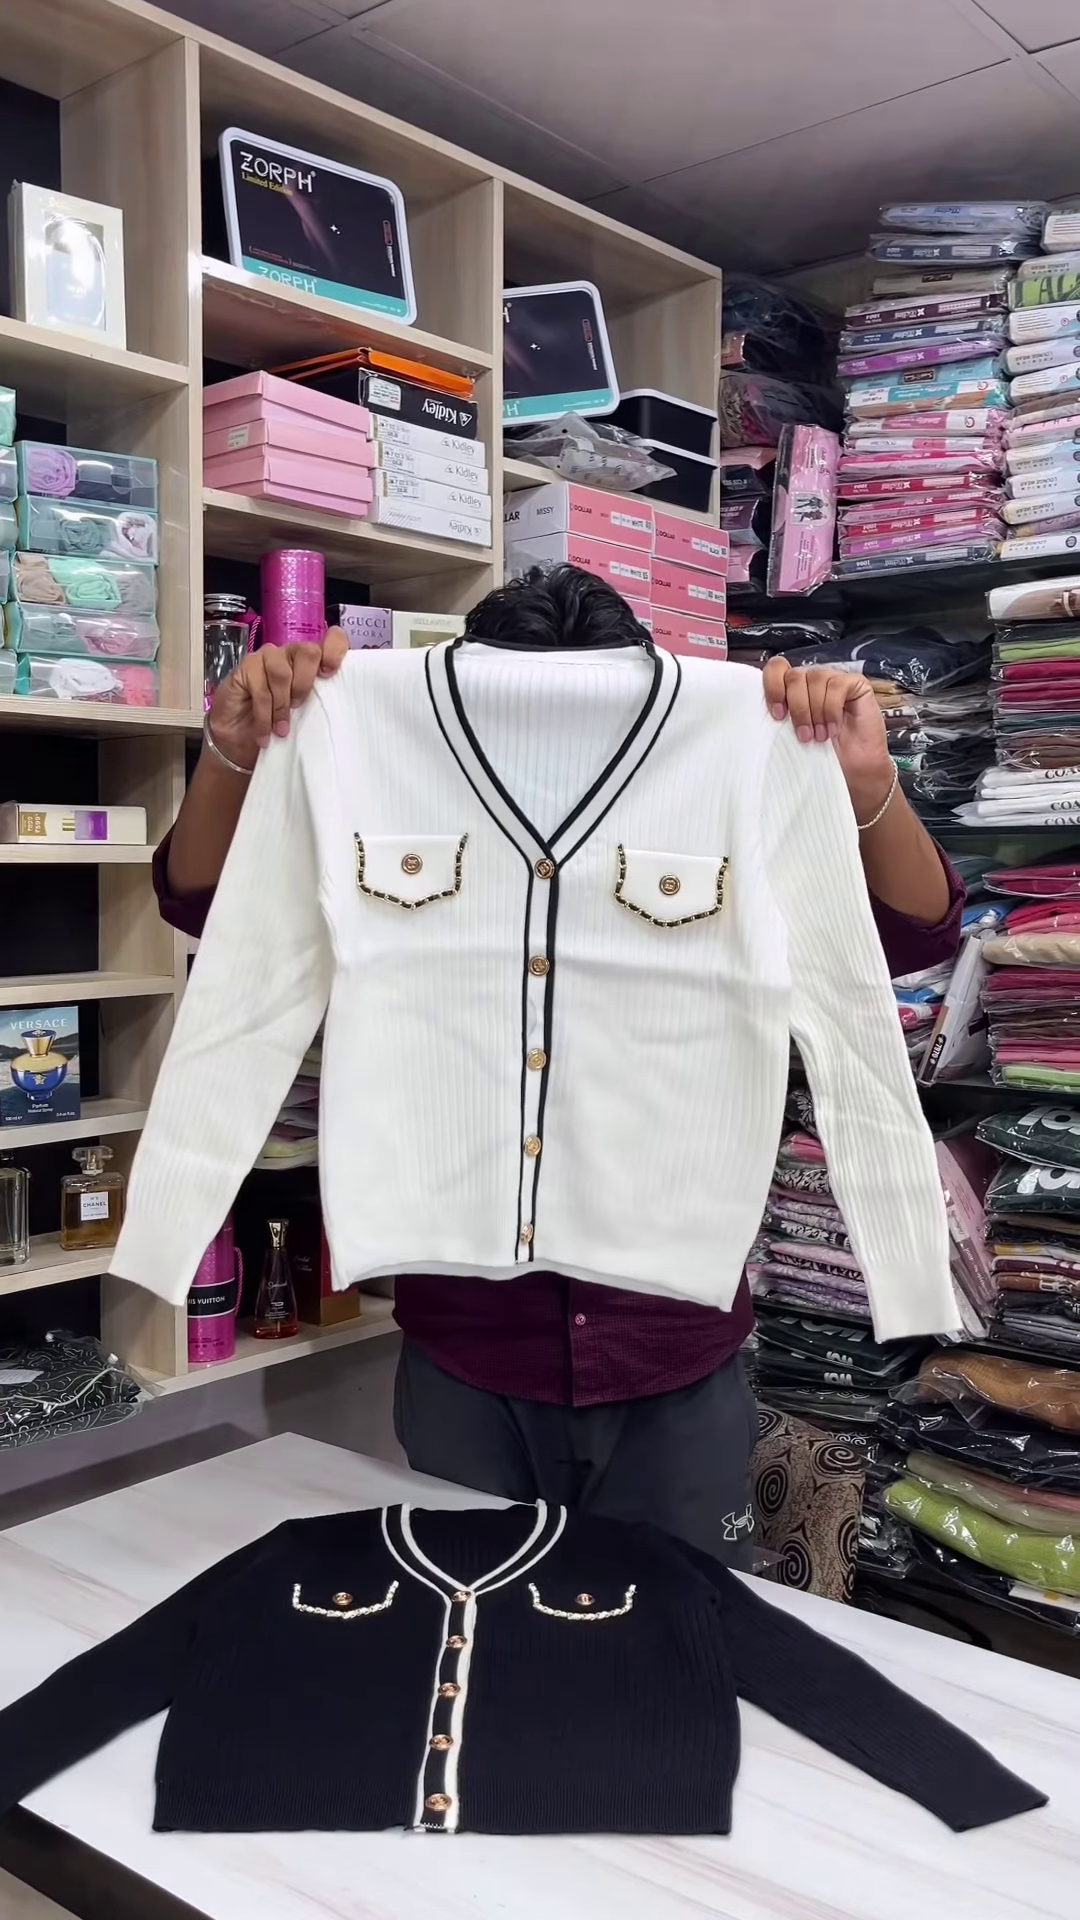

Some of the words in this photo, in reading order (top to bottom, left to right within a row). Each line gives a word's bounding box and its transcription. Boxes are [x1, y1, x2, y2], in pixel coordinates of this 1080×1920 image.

[242, 172, 268, 189] Limited
[268, 180, 294, 197] Edition
[422, 398, 458, 425] Kidley
[451, 438, 475, 456] Kidley
[455, 465, 480, 483] Kidley
[459, 492, 482, 510] Kidley
[536, 506, 554, 516] MISSY
[574, 504, 592, 514] DOLLAR
[450, 520, 473, 536] Kidley
[659, 530, 676, 540] DOLLAR
[572, 555, 591, 565] DOLLAR
[655, 579, 672, 588] DOLLAR
[346, 616, 387, 629] GUCCI
[350, 628, 384, 638] FLORA
[655, 628, 672, 636] DOLLAR
[10, 1018, 68, 1030] VERSACE
[197, 1296, 226, 1304] VUITTON
